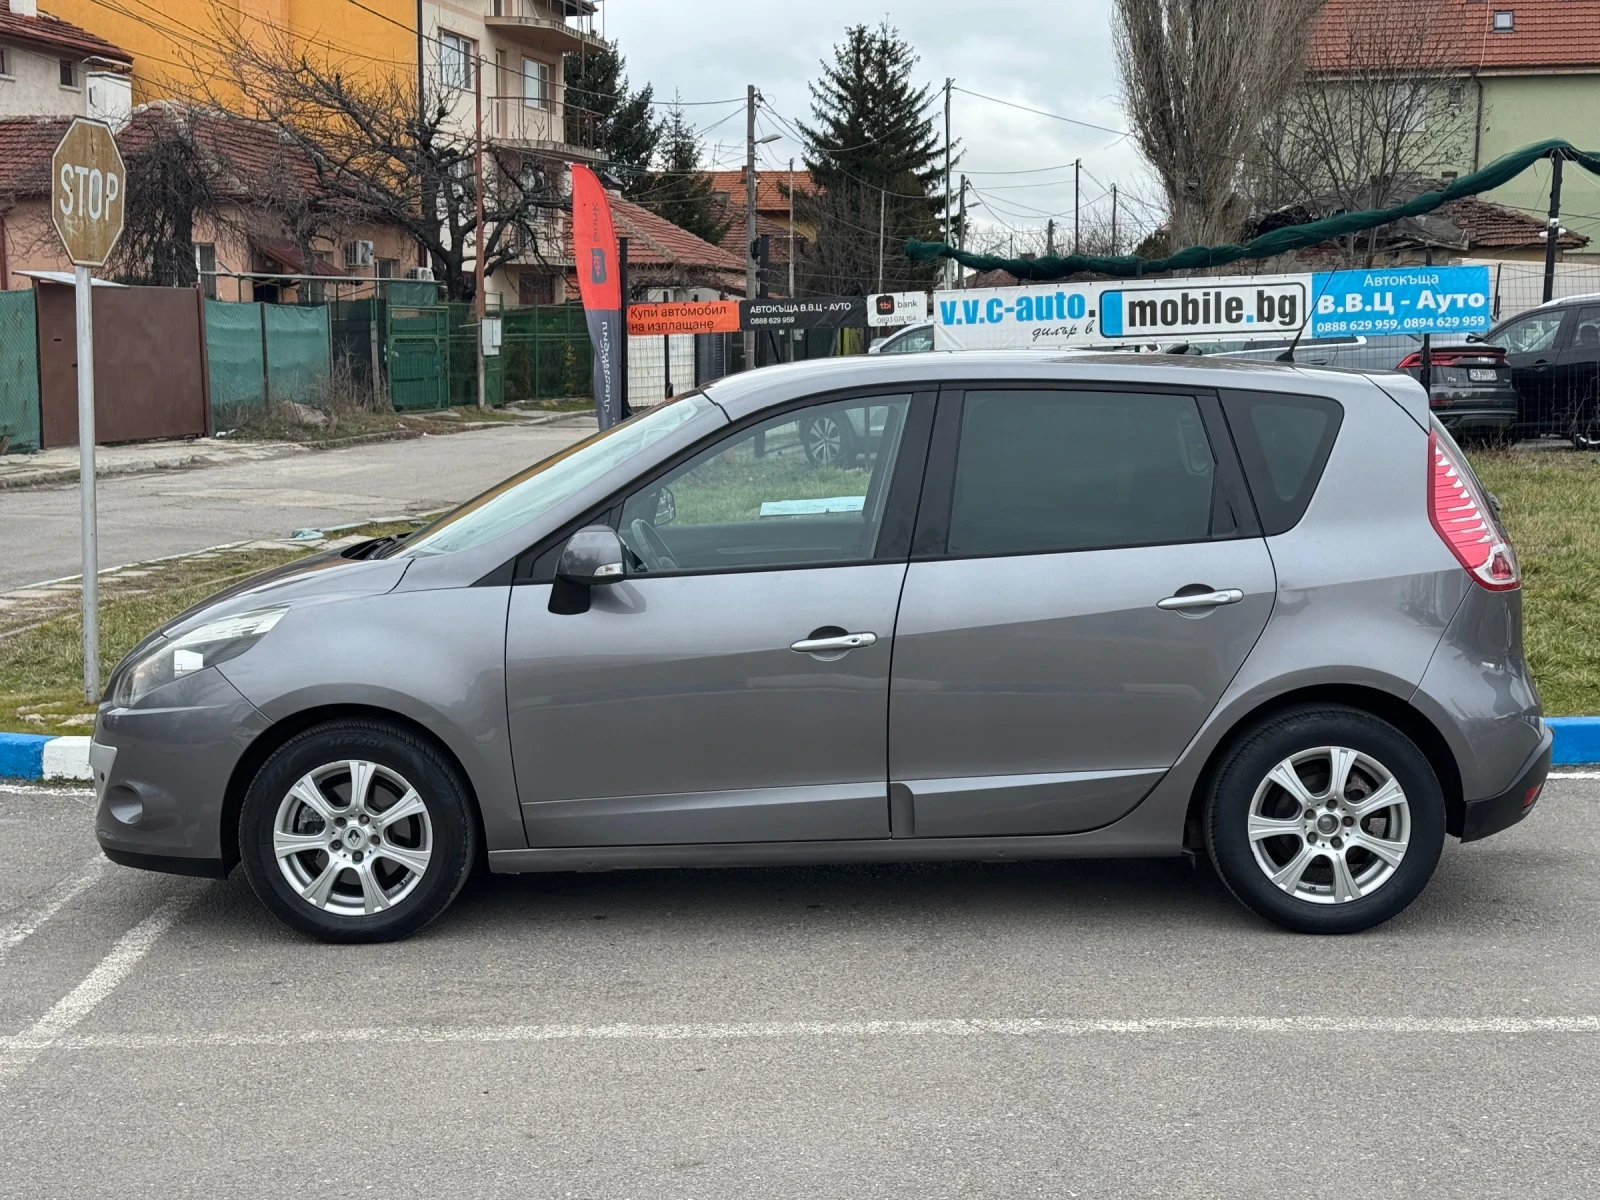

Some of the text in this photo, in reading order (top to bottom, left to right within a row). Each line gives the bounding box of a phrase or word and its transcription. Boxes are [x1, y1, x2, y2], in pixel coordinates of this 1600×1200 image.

[60, 163, 118, 221] STOP
[1364, 274, 1439, 287] Автокъща
[750, 304, 798, 314] АВТОКЪЩА
[800, 303, 822, 312] В.В.Ц
[829, 302, 852, 311] АУТО
[880, 300, 918, 309] tbi bank
[1128, 290, 1297, 327] mobile.bg
[1317, 292, 1394, 315] В.В.Ц
[1416, 290, 1485, 314] Ауто
[630, 306, 726, 320] Купи автомобил
[632, 320, 714, 332] на изплащане
[1032, 320, 1095, 342] дилър в
[1317, 316, 1485, 332] 0888 629 959, 0894 629 959
